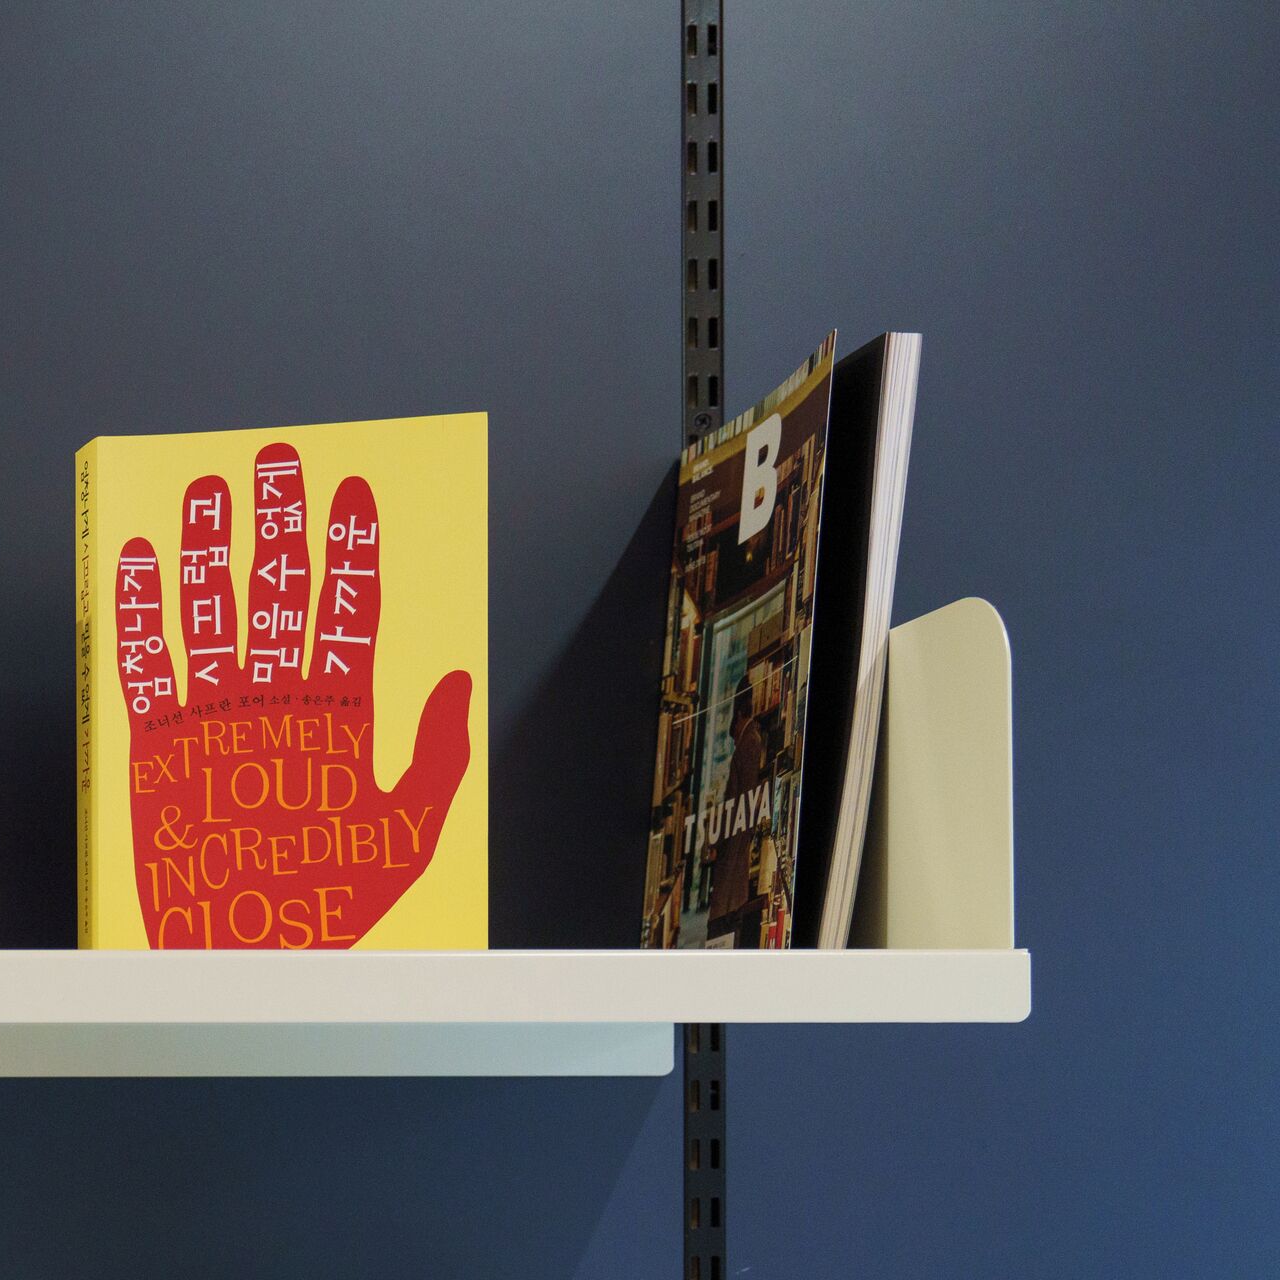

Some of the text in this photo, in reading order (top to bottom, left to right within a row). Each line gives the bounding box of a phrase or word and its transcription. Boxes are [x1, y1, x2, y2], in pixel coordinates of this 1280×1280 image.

[738, 413, 781, 545] B
[181, 492, 235, 686] 시끄럽고
[250, 460, 306, 684] 믿을 수 없게
[320, 515, 378, 675] 가까운
[120, 557, 172, 714] 엄청나게
[132, 712, 370, 794] EXTREMELY
[144, 711, 185, 733] 조너선
[190, 698, 232, 719] 사프란
[153, 805, 198, 851] &
[201, 757, 358, 823] LOUD
[684, 780, 771, 854] TSUTAYA
[144, 806, 433, 912] INCREDIBLY
